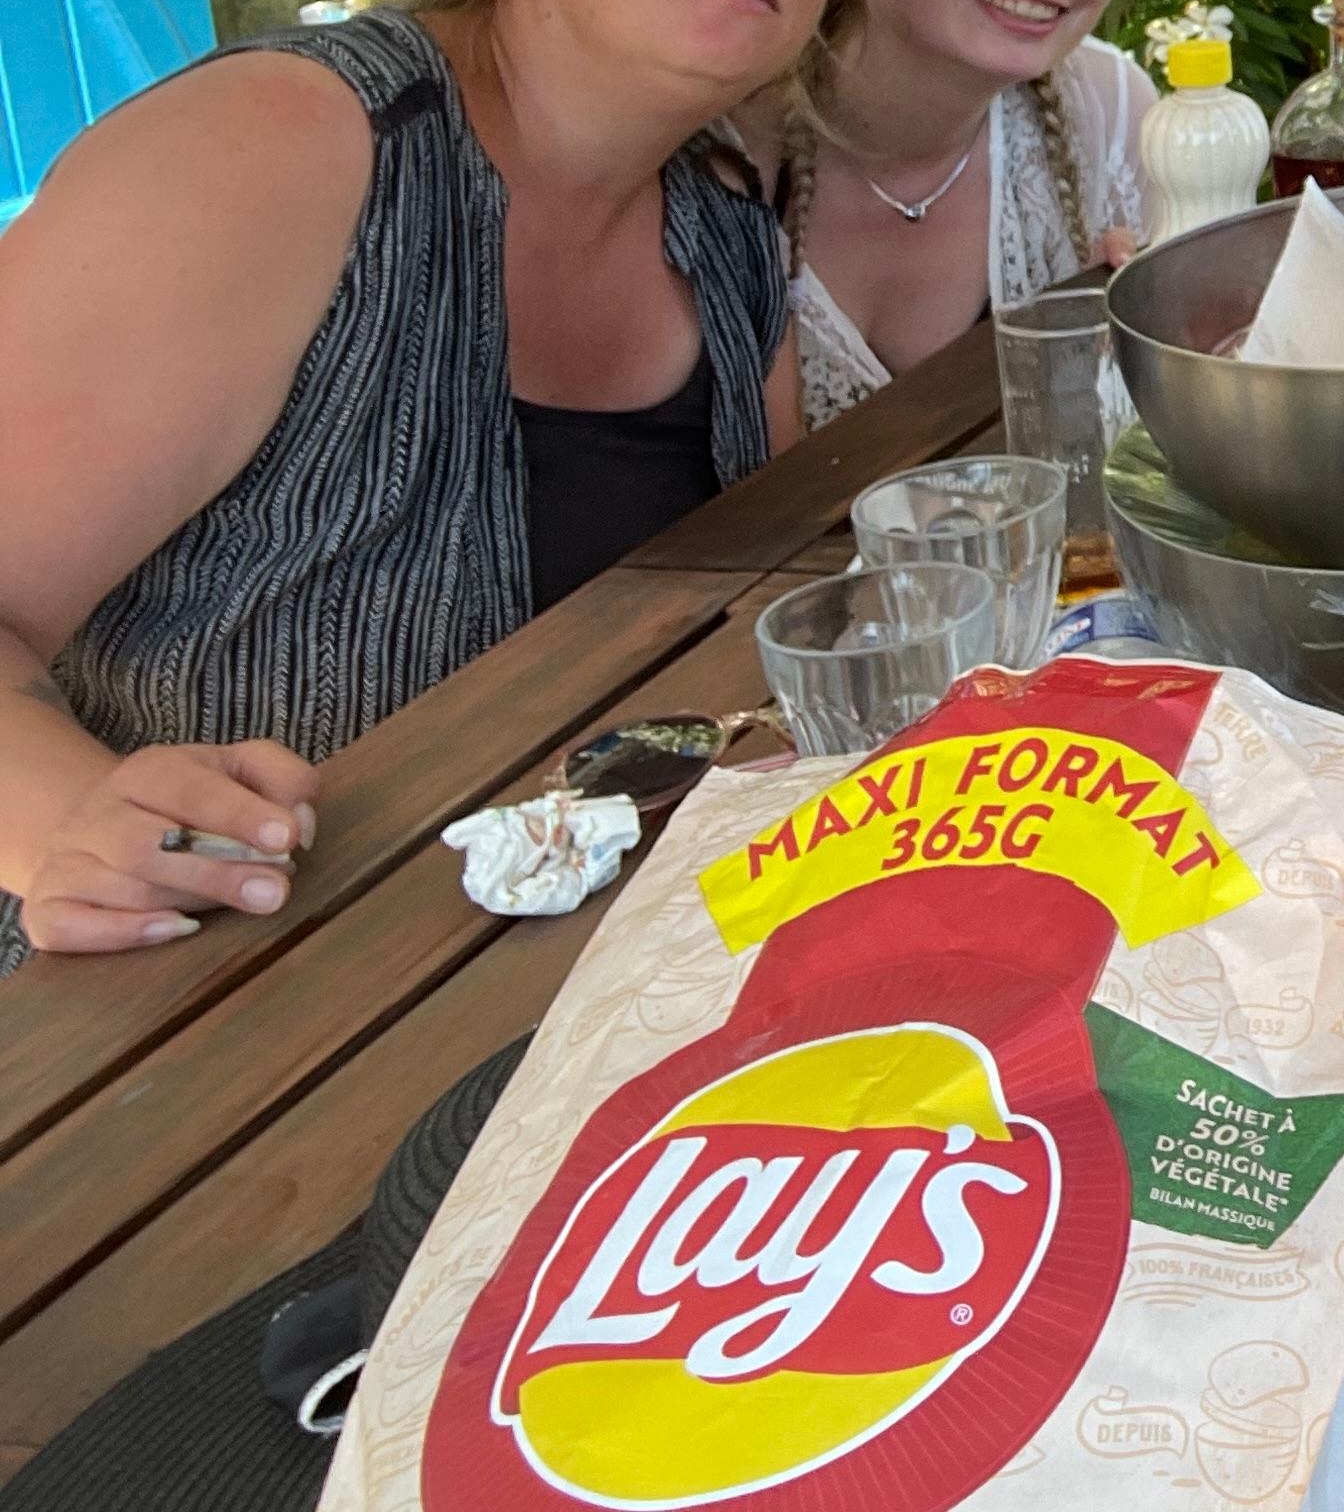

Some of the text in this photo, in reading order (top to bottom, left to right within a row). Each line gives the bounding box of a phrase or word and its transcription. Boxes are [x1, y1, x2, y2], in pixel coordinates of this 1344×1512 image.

[747, 737, 1220, 881] MAXI FORMAT
[881, 803, 1055, 871] 365G
[1176, 1079, 1297, 1133] SACHET À
[1155, 1135, 1293, 1191] D'ORIGINE
[1190, 1118, 1270, 1156] 50%
[1149, 1187, 1277, 1233] BILAN MASSIQUE
[527, 1124, 1029, 1379] Lay's
[1138, 1258, 1296, 1289] 100% FRANÇAISES
[1097, 1423, 1173, 1445] DEPUIS
